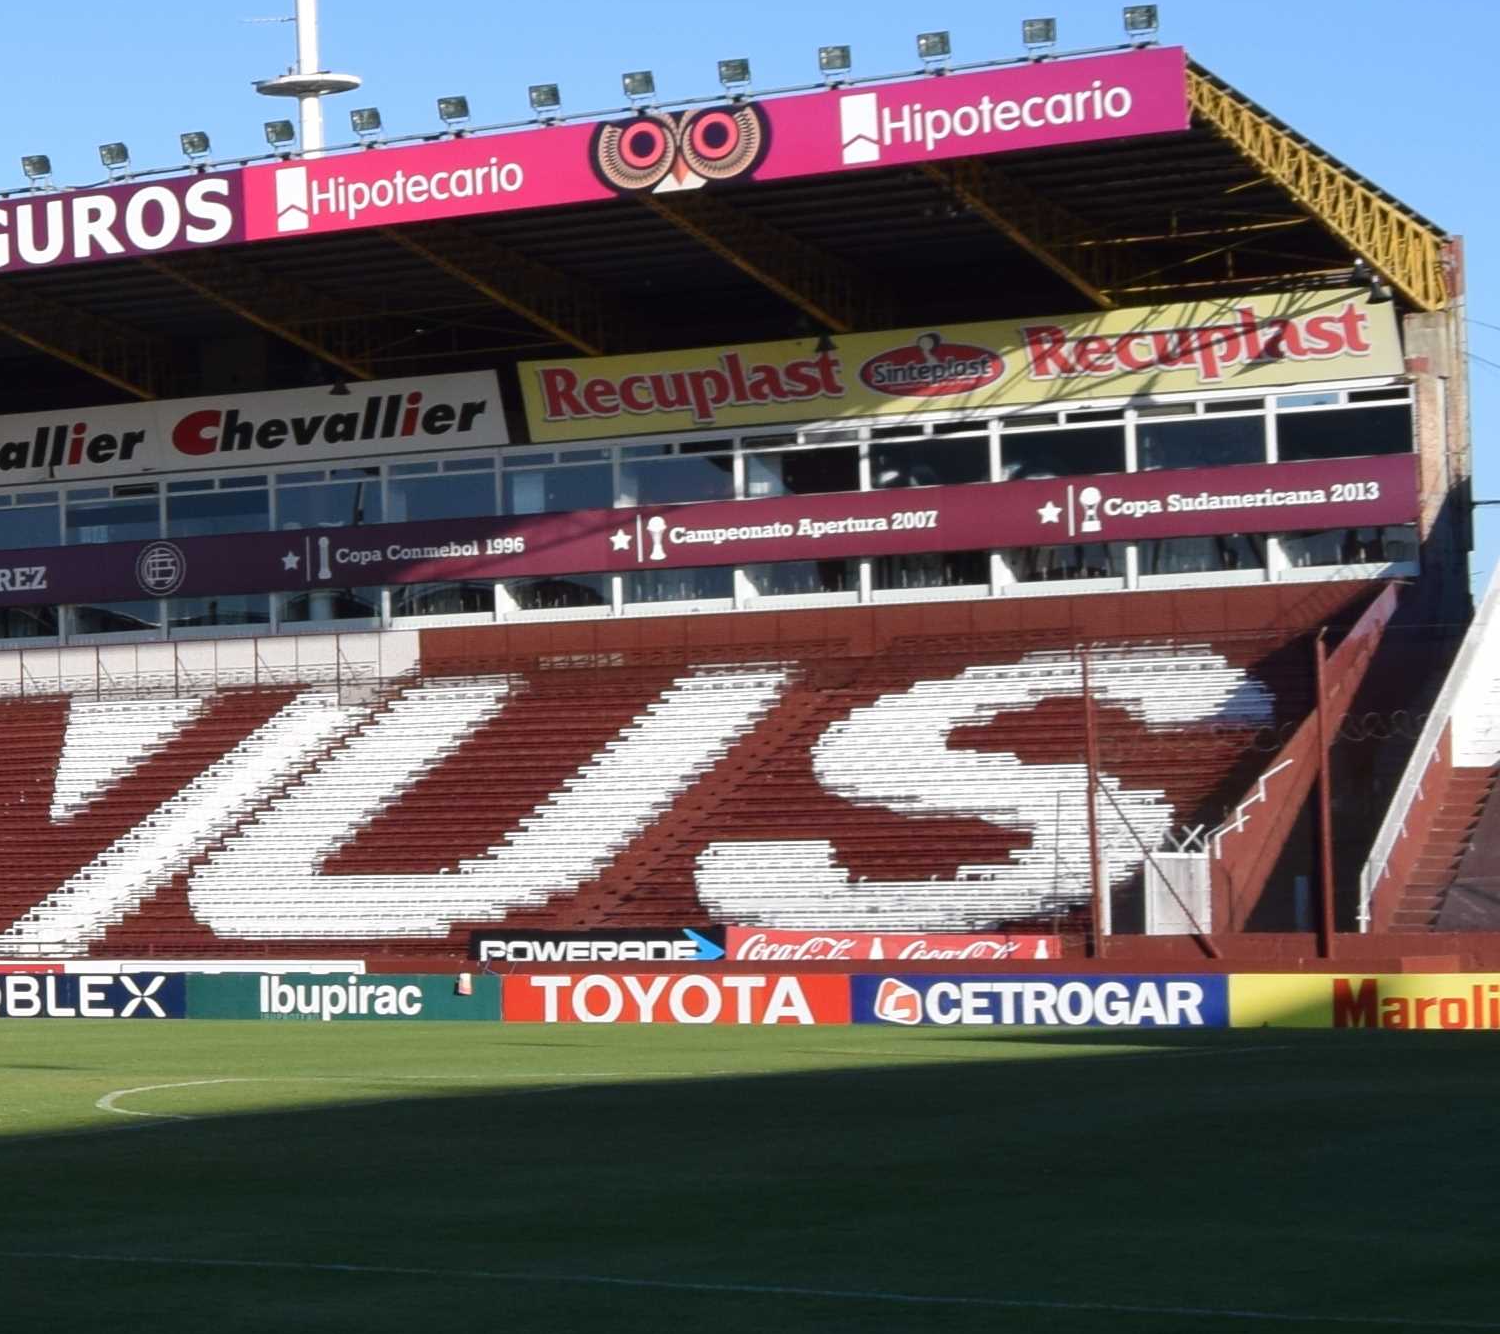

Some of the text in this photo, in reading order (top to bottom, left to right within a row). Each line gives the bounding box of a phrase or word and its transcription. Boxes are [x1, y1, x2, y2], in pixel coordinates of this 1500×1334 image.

[882, 80, 1131, 150] Hipotecario
[312, 158, 523, 220] Hipotecario
[1025, 303, 1369, 381] Recuplast
[544, 353, 842, 420] Recuplast
[874, 359, 990, 383] Sinteplast
[172, 391, 485, 455] Chevallier
[1104, 481, 1380, 517] Copa Sudamericana 2013
[669, 510, 939, 546] Campeonato Apertura 2007
[335, 536, 525, 568] Copa Conmebol 1996
[479, 939, 698, 961] POWERADE
[259, 974, 422, 1021] Ibupirac
[531, 975, 814, 1024] TOYOTA
[926, 981, 1204, 1025] CETROGAR
